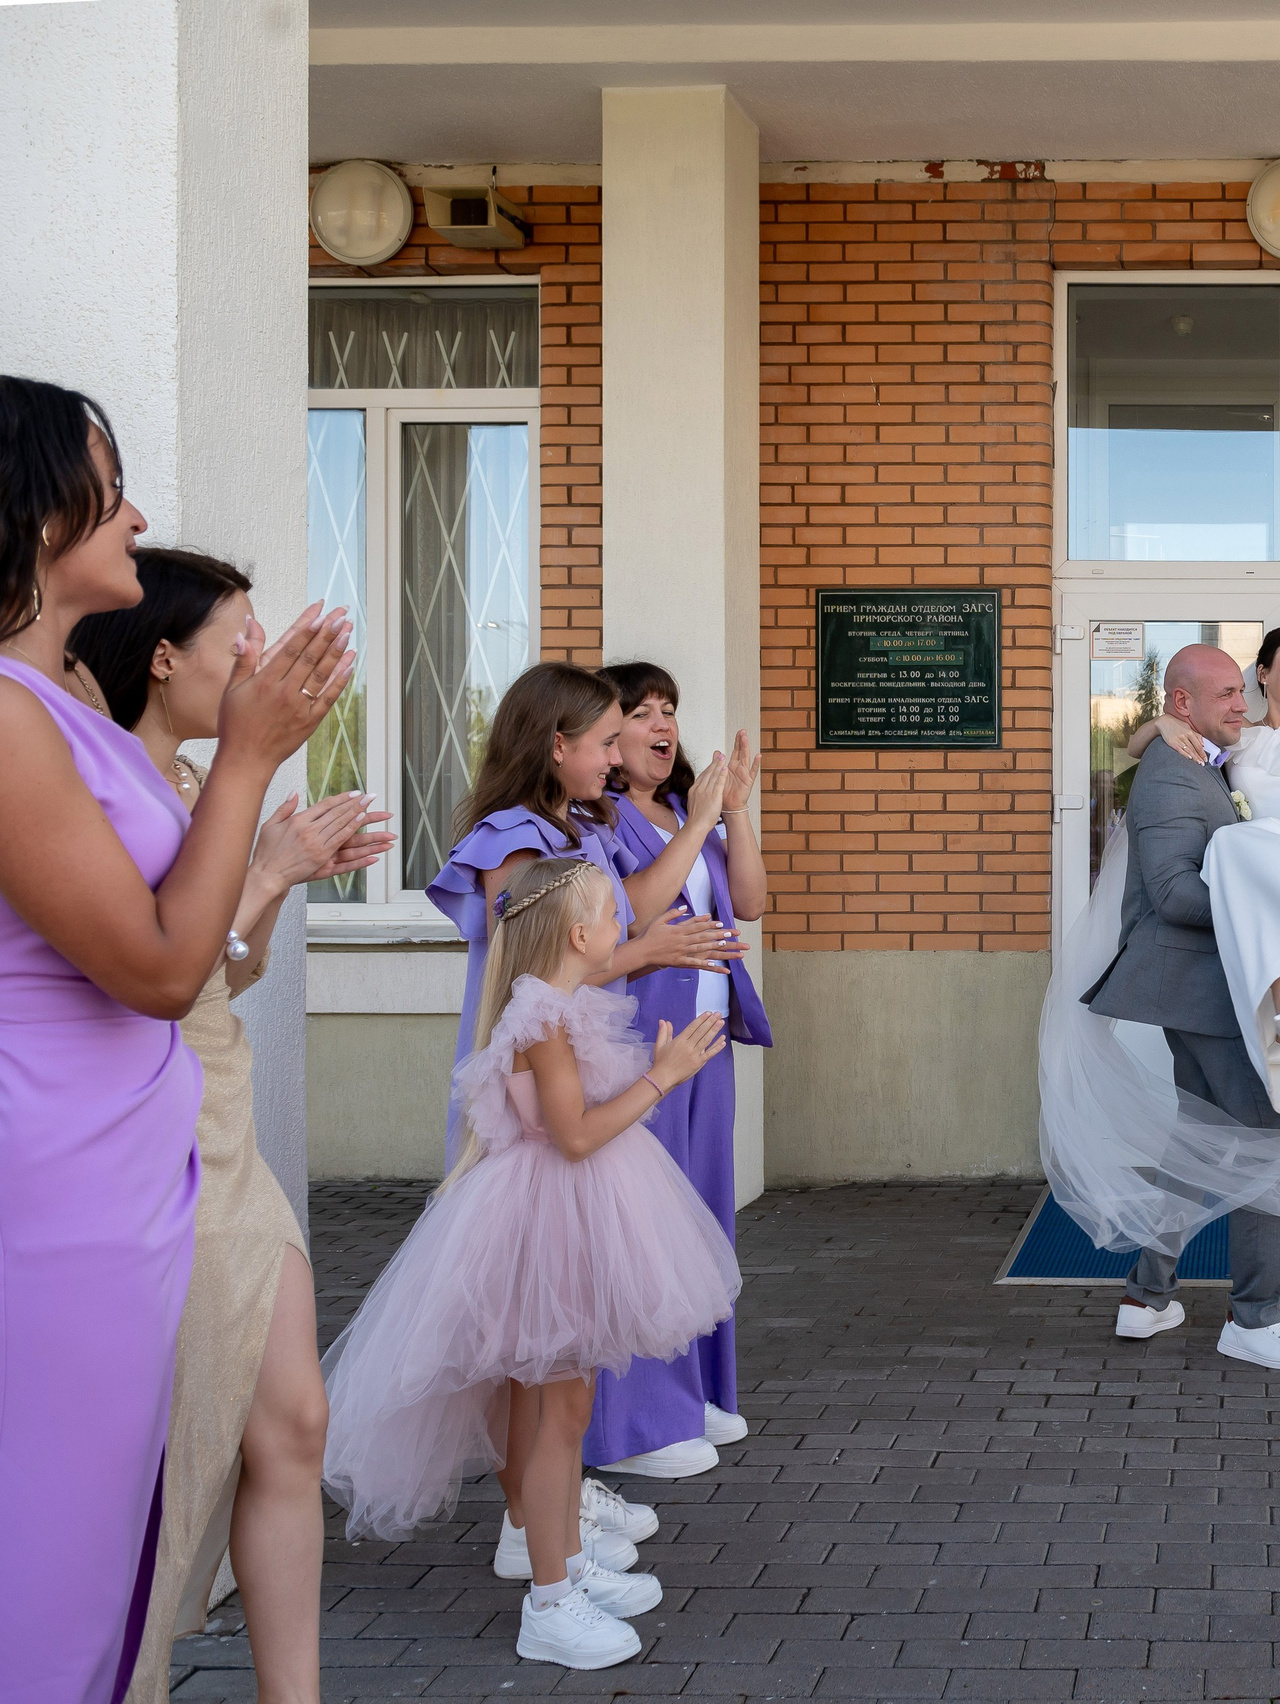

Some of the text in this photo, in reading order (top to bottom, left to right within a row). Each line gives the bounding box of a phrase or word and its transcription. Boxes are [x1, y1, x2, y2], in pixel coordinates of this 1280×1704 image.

[824, 603, 993, 613] ПРИЕМ ГРАЖДАН ОТДЕЛОМ ЗАГС
[853, 614, 963, 622] ПРИМОРСКОГО РАЙОНА
